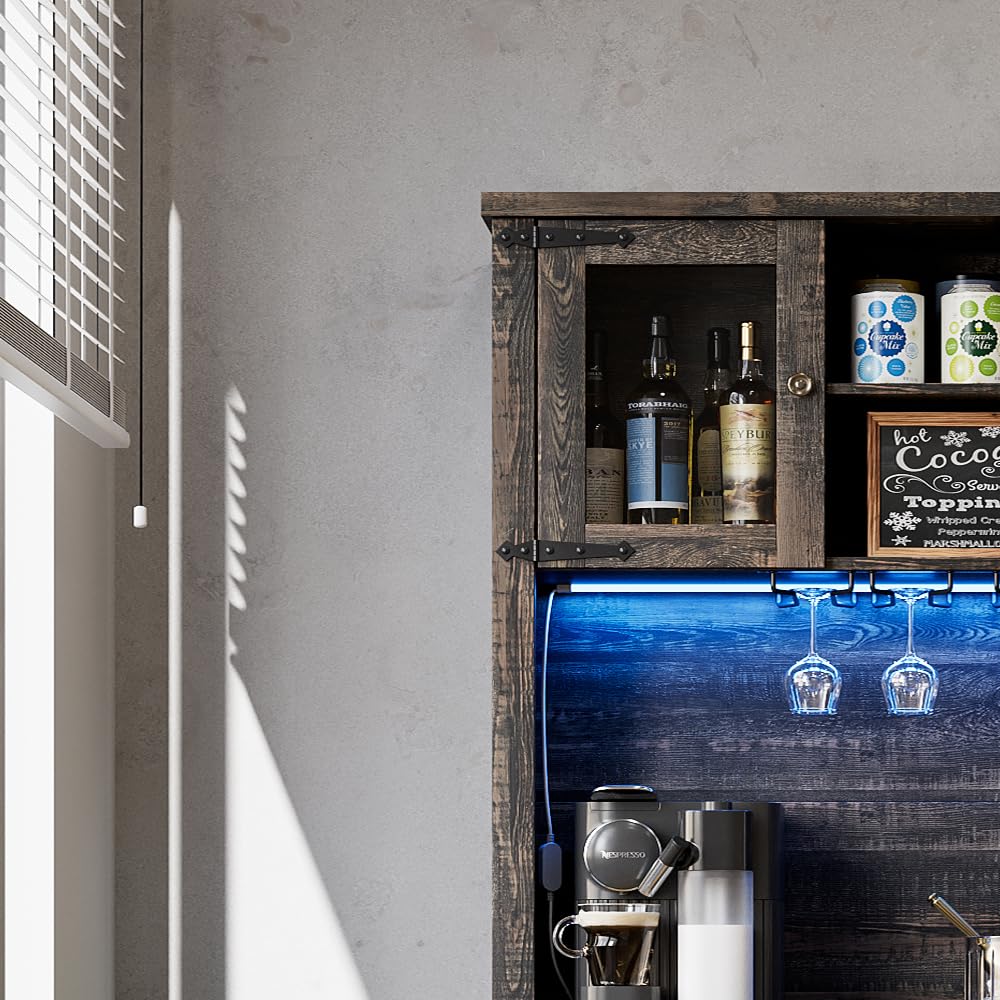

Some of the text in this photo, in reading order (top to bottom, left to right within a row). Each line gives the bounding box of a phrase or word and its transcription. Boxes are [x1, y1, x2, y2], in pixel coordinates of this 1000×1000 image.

[870, 332, 904, 342] Cupcake
[961, 332, 996, 342] Cupcake
[883, 341, 901, 350] Mix
[974, 341, 992, 350] Mix
[893, 428, 932, 446] hot
[926, 516, 977, 526] Whipped
[600, 850, 646, 859] NESPRESSO
